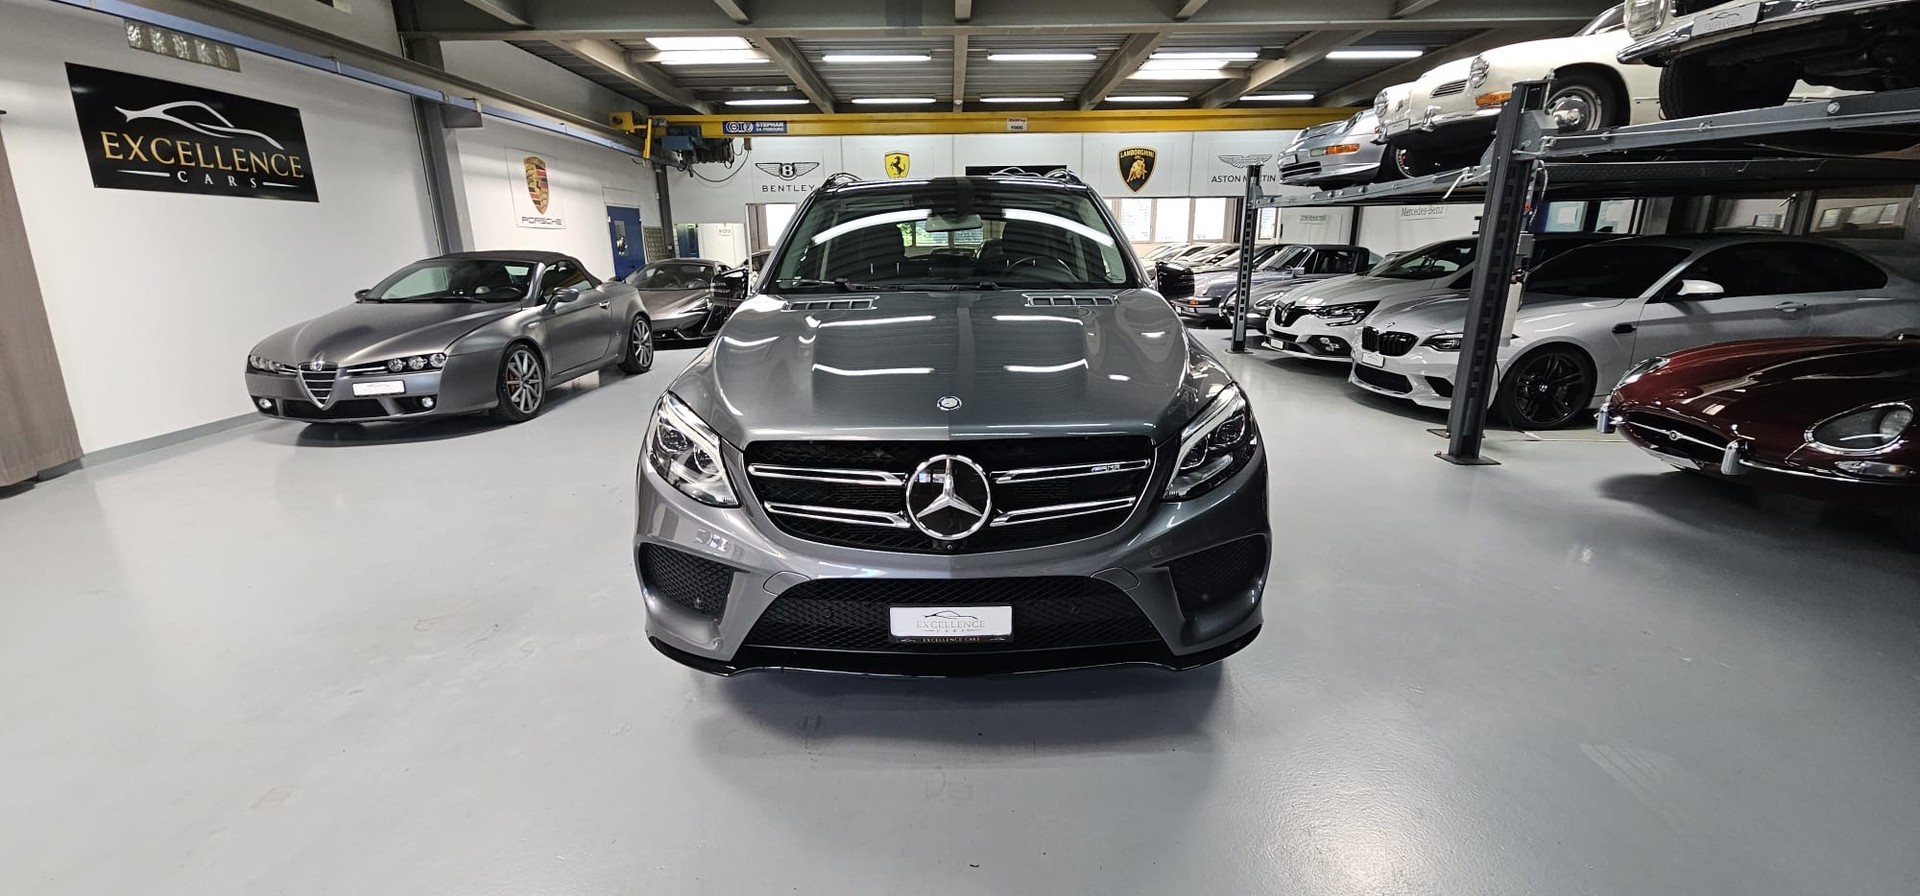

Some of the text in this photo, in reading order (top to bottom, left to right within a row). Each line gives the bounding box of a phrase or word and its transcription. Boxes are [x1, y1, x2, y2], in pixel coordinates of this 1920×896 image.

[101, 131, 304, 178] EXCELLENCE
[1120, 149, 1155, 158] LAMBORGHINI
[177, 170, 257, 188] CARS
[1211, 175, 1240, 183] ASTON
[1401, 206, 1445, 217] Mercedes-Benz
[522, 216, 562, 225] PORSCHE
[917, 620, 986, 629] EXCELLENCE
